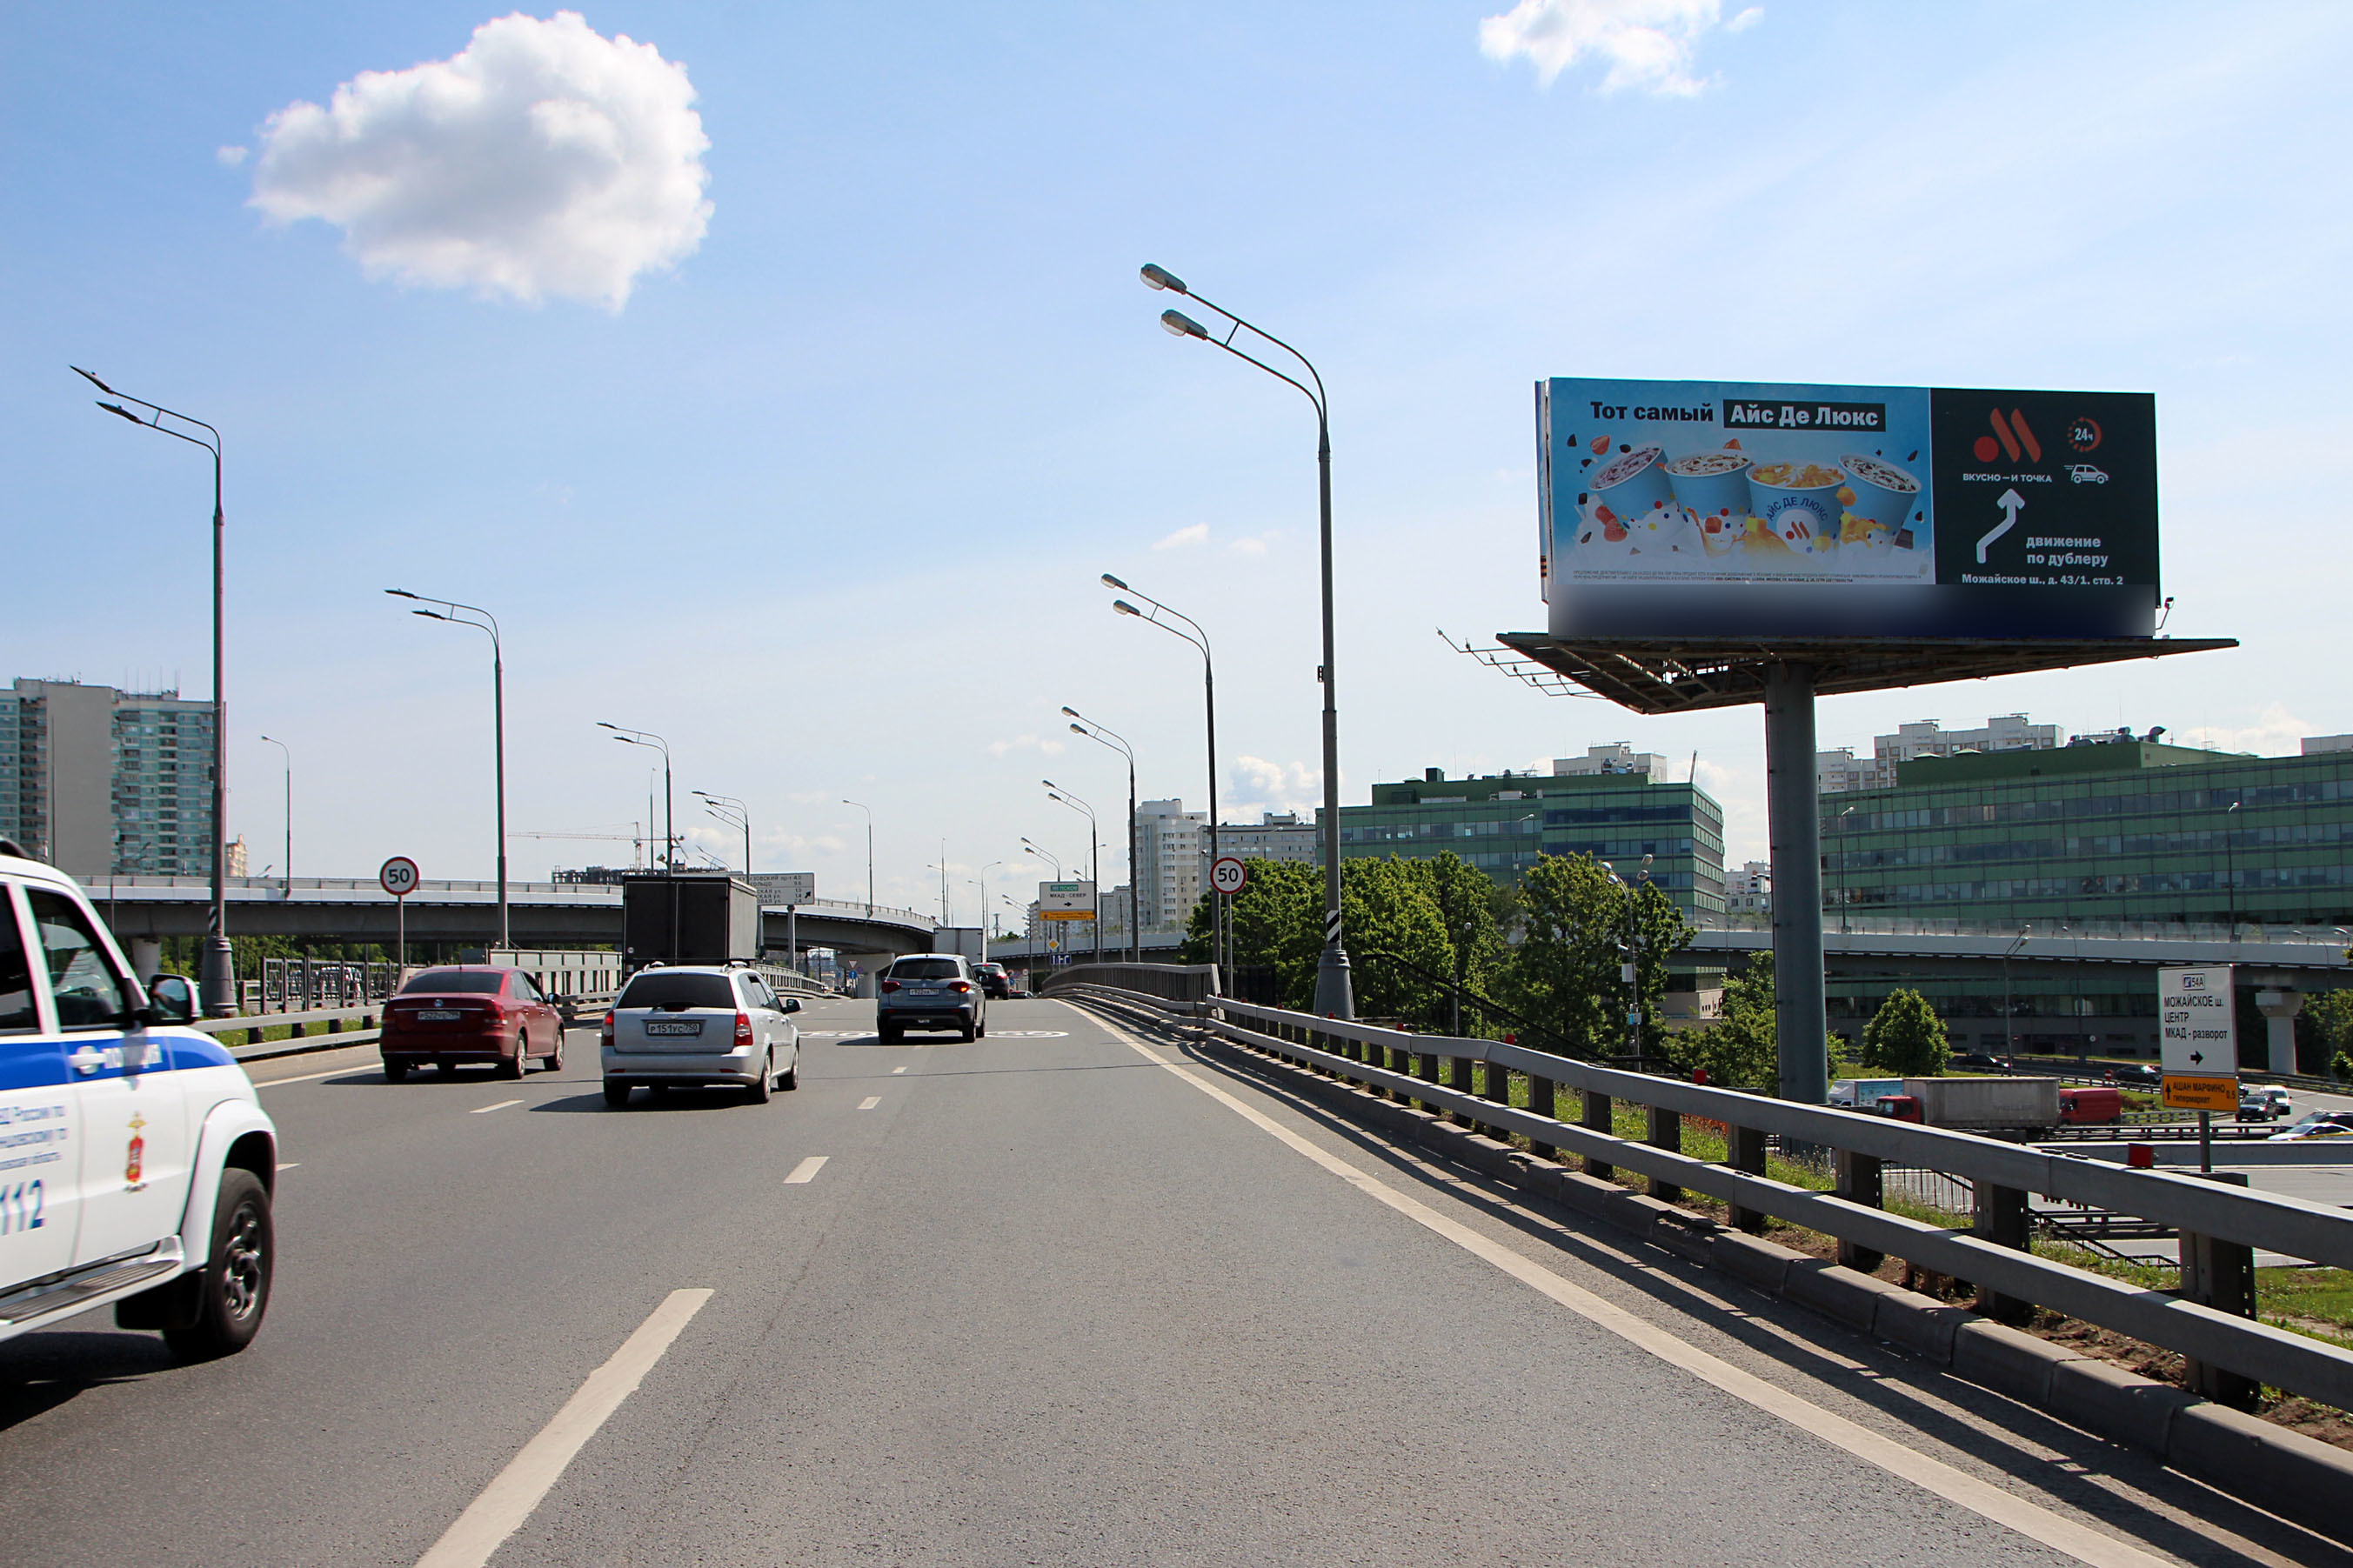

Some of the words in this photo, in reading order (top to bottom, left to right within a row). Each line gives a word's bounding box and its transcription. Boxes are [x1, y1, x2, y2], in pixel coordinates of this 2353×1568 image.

[1590, 401, 1628, 420] Тот
[1634, 404, 1714, 423] самый
[1730, 404, 1775, 424] Айс
[1779, 406, 1809, 427] Де
[1815, 406, 1879, 426] Люкс
[1962, 473, 2002, 483] ВКУСНО
[2020, 474, 2054, 484] ТОЧКА
[1766, 501, 1781, 521] АЙС
[1782, 497, 1798, 509] ДЕ
[1801, 497, 1828, 521] ЛЮКС
[2026, 537, 2102, 549] движение
[2027, 554, 2045, 564] по
[2048, 552, 2109, 567] дублеру
[1962, 573, 2027, 584] Можайское
[2116, 576, 2124, 584] 2
[388, 868, 411, 884] 50
[1218, 867, 1239, 883] 50
[2164, 994, 2213, 1007] МОЖАЙСКОЕ
[2164, 1011, 2189, 1024] ЦЕНТР
[2165, 1027, 2187, 1040] МКАД
[2192, 1030, 2228, 1041] разворот
